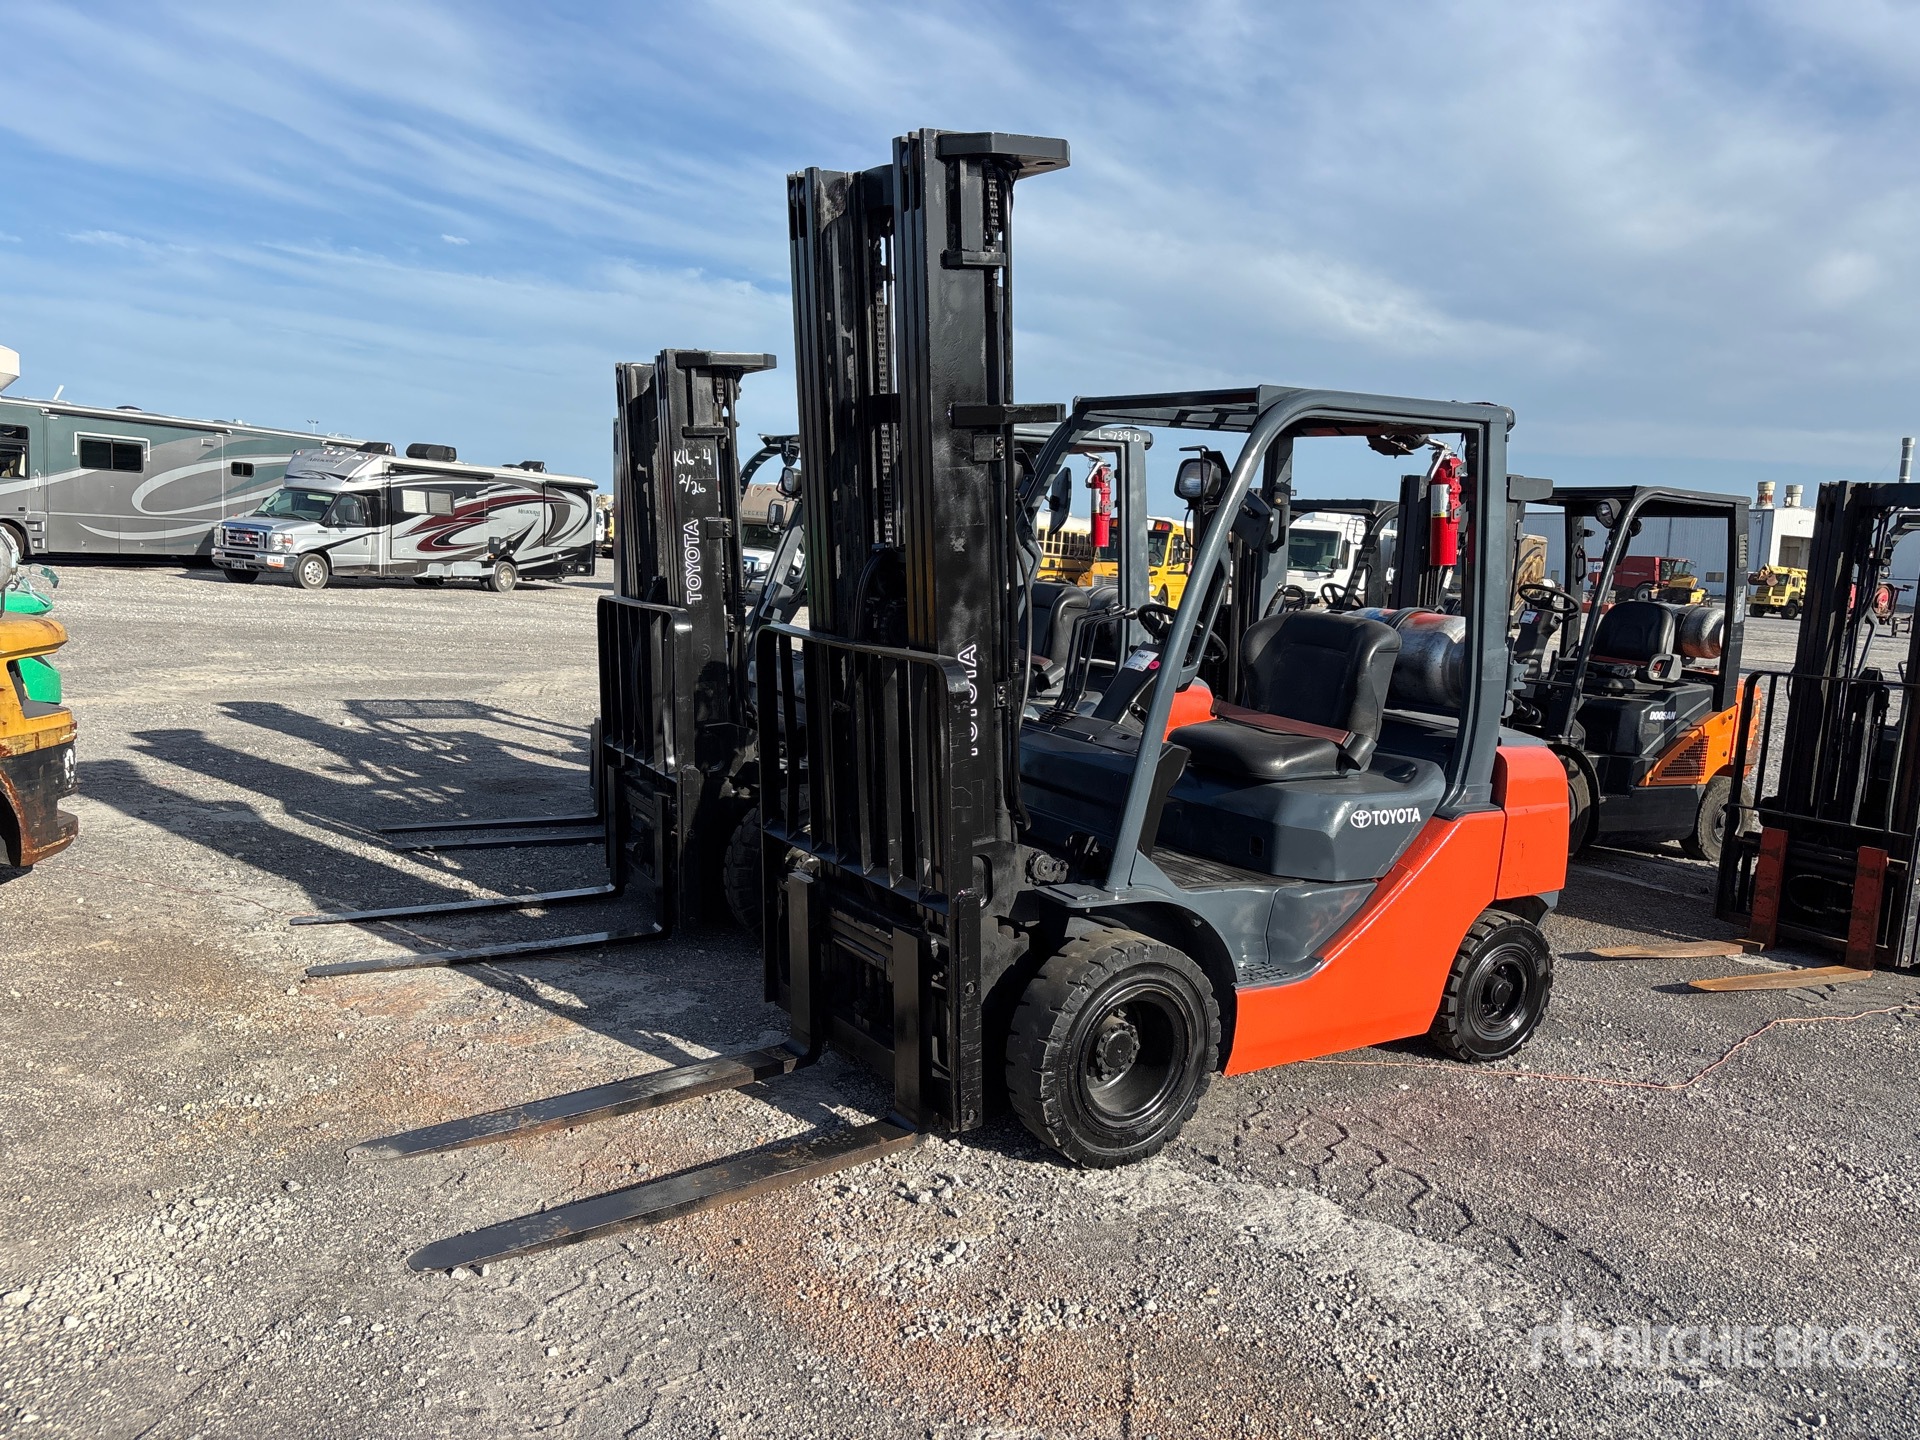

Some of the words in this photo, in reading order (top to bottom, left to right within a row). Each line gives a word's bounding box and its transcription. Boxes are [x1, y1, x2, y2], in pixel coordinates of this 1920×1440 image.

[678, 473, 707, 495] 2/26
[683, 518, 703, 605] TOYOTA
[1649, 710, 1677, 720] DOOSAN
[1371, 807, 1421, 826] TOYOTA
